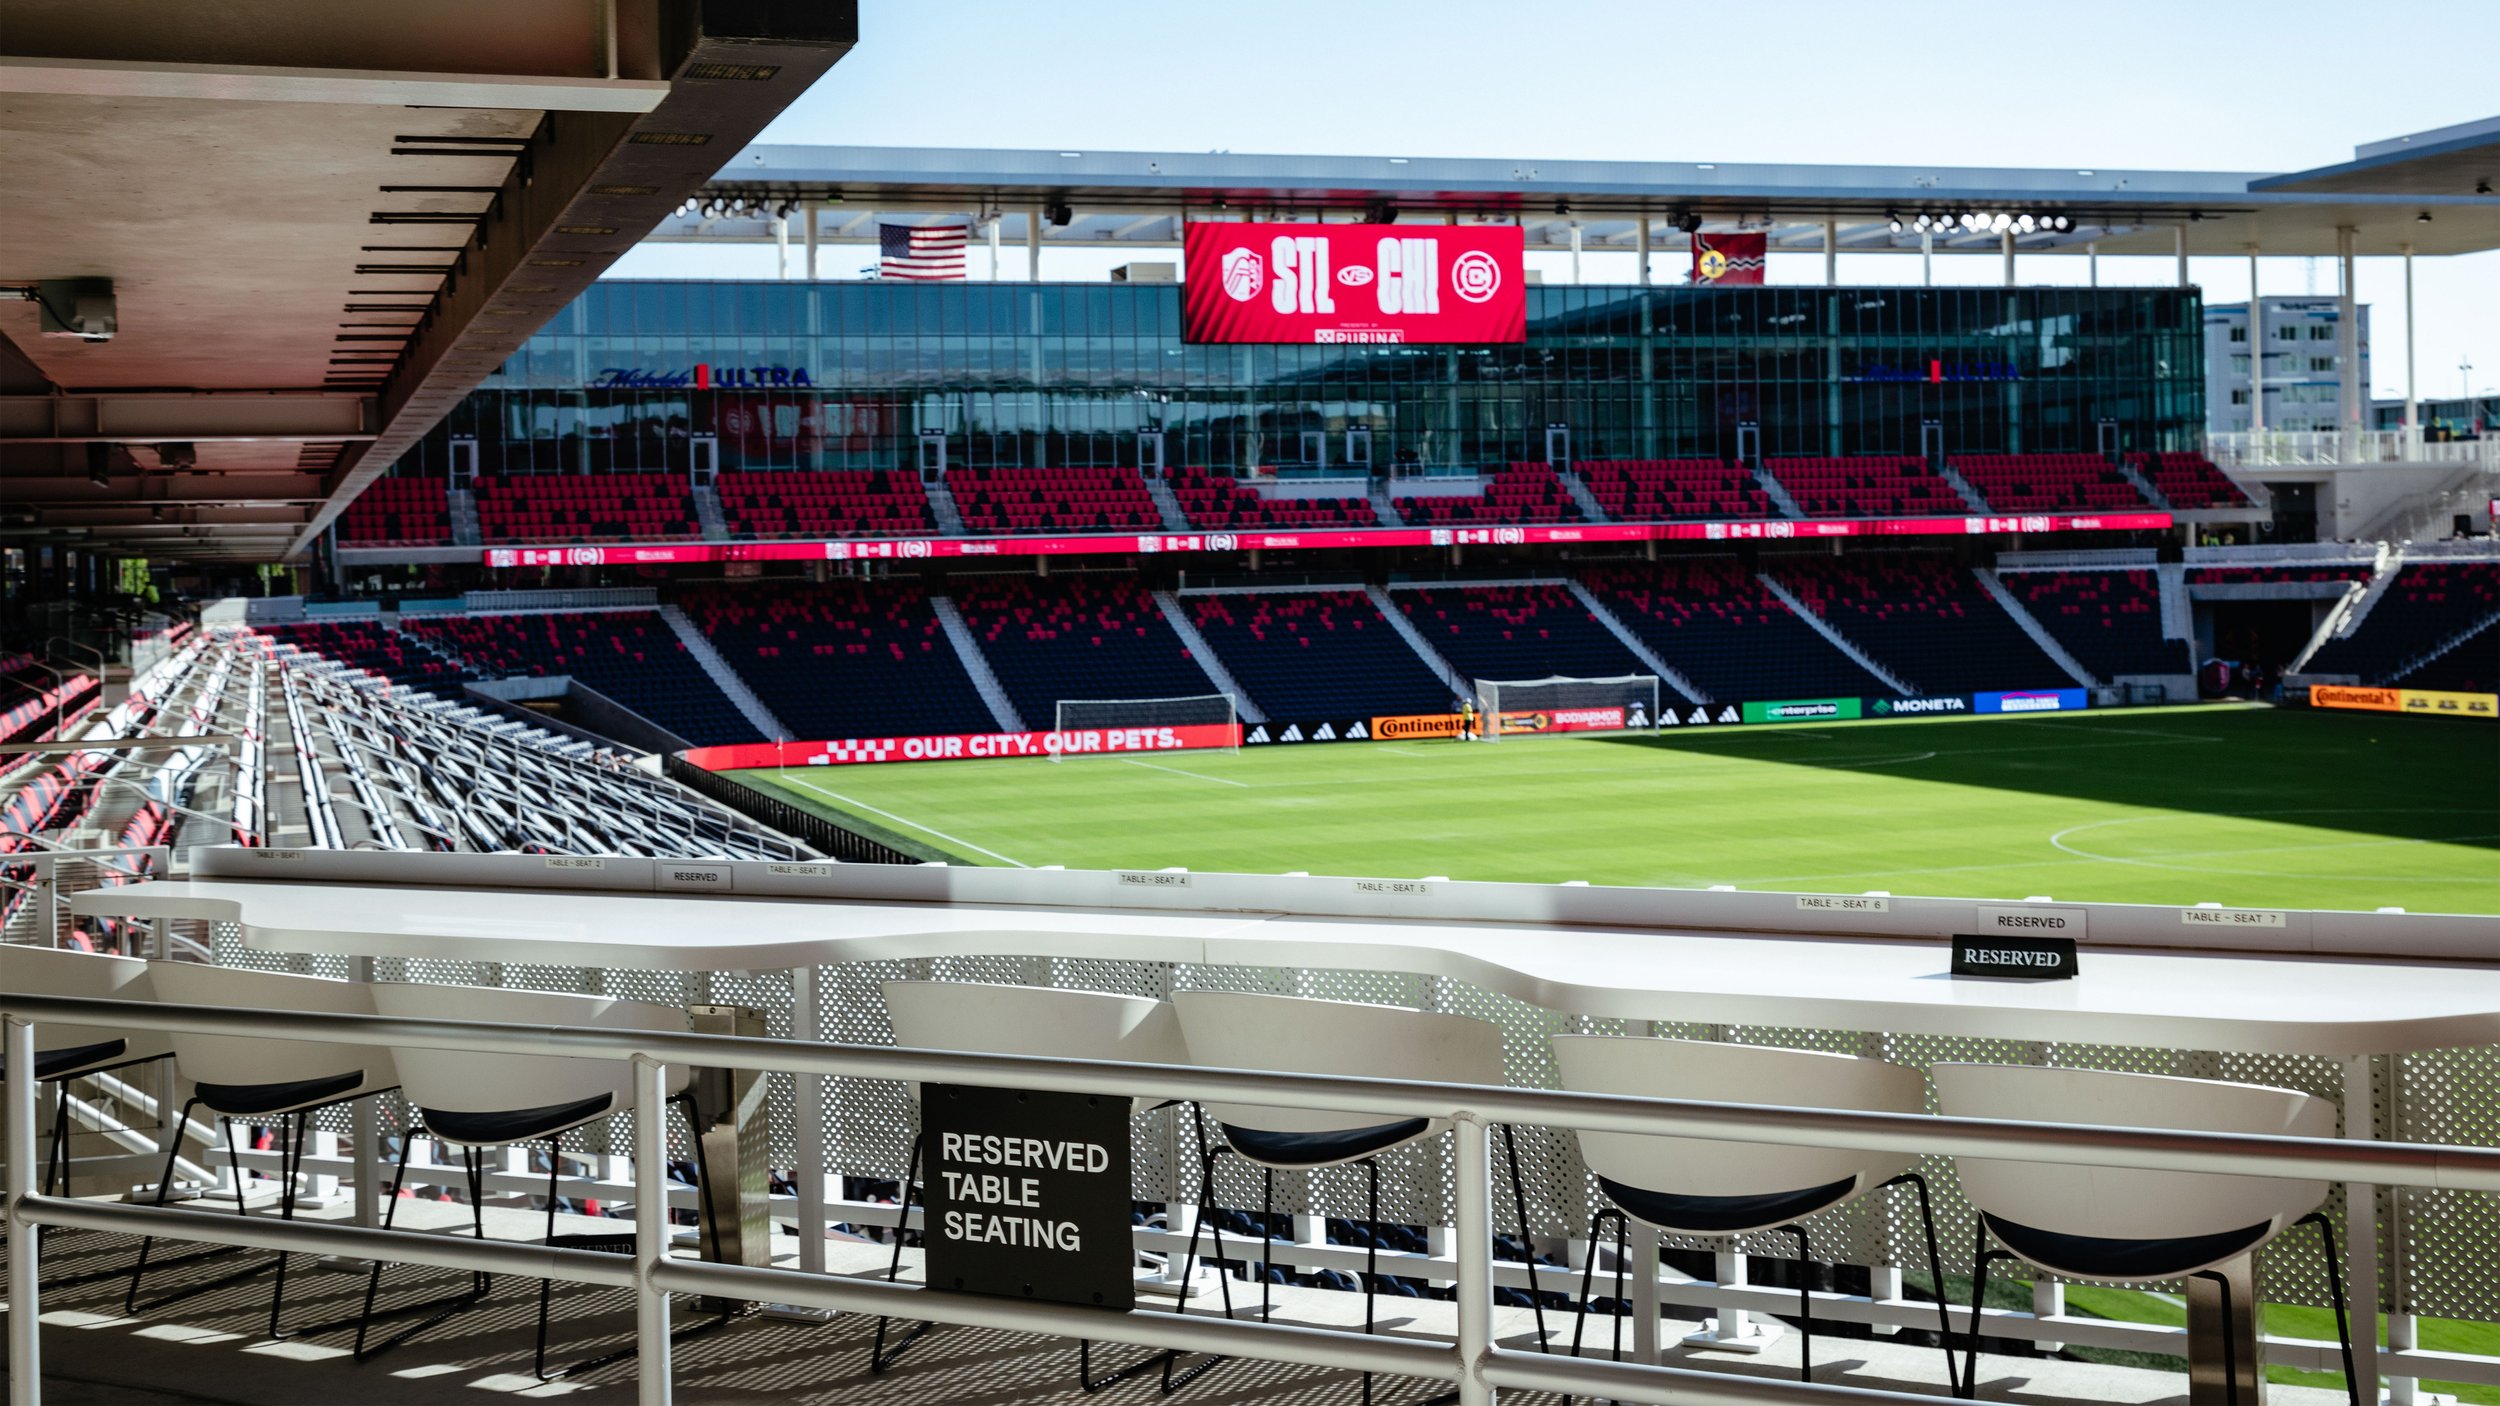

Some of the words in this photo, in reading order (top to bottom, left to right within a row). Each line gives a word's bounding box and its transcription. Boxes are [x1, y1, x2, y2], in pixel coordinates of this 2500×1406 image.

[1271, 235, 1335, 314] STL
[1377, 237, 1440, 315] CHI
[1336, 332, 1399, 343] PURINA
[714, 367, 812, 387] ULTRA
[2316, 688, 2385, 705] Continental
[1893, 698, 1965, 712] MONETA
[1555, 710, 1621, 724] BODYARMOR
[903, 737, 962, 759] OUR
[969, 734, 1038, 757] CITY.
[1043, 730, 1100, 752] OUR
[1107, 727, 1183, 749] PETS.
[548, 859, 569, 867] TABLE
[770, 865, 792, 874] TABLE
[799, 866, 817, 875] SEAT
[674, 871, 718, 882] RESERVED
[1121, 875, 1146, 884] TABLE
[1155, 876, 1174, 884] SEAT
[1357, 882, 1384, 892] TABLE
[1393, 883, 1415, 893] SEAT
[1801, 898, 1832, 908] TABLE
[1842, 899, 1868, 909] SEAT
[1998, 916, 2066, 929] RESERVED
[2186, 912, 2221, 923] TABLE
[2234, 913, 2262, 924] SEAT
[1964, 948, 2061, 967] RESERVED
[942, 1132, 1109, 1173] RESERVED
[942, 1172, 1040, 1208] TABLE
[944, 1211, 1081, 1252] SEATING
